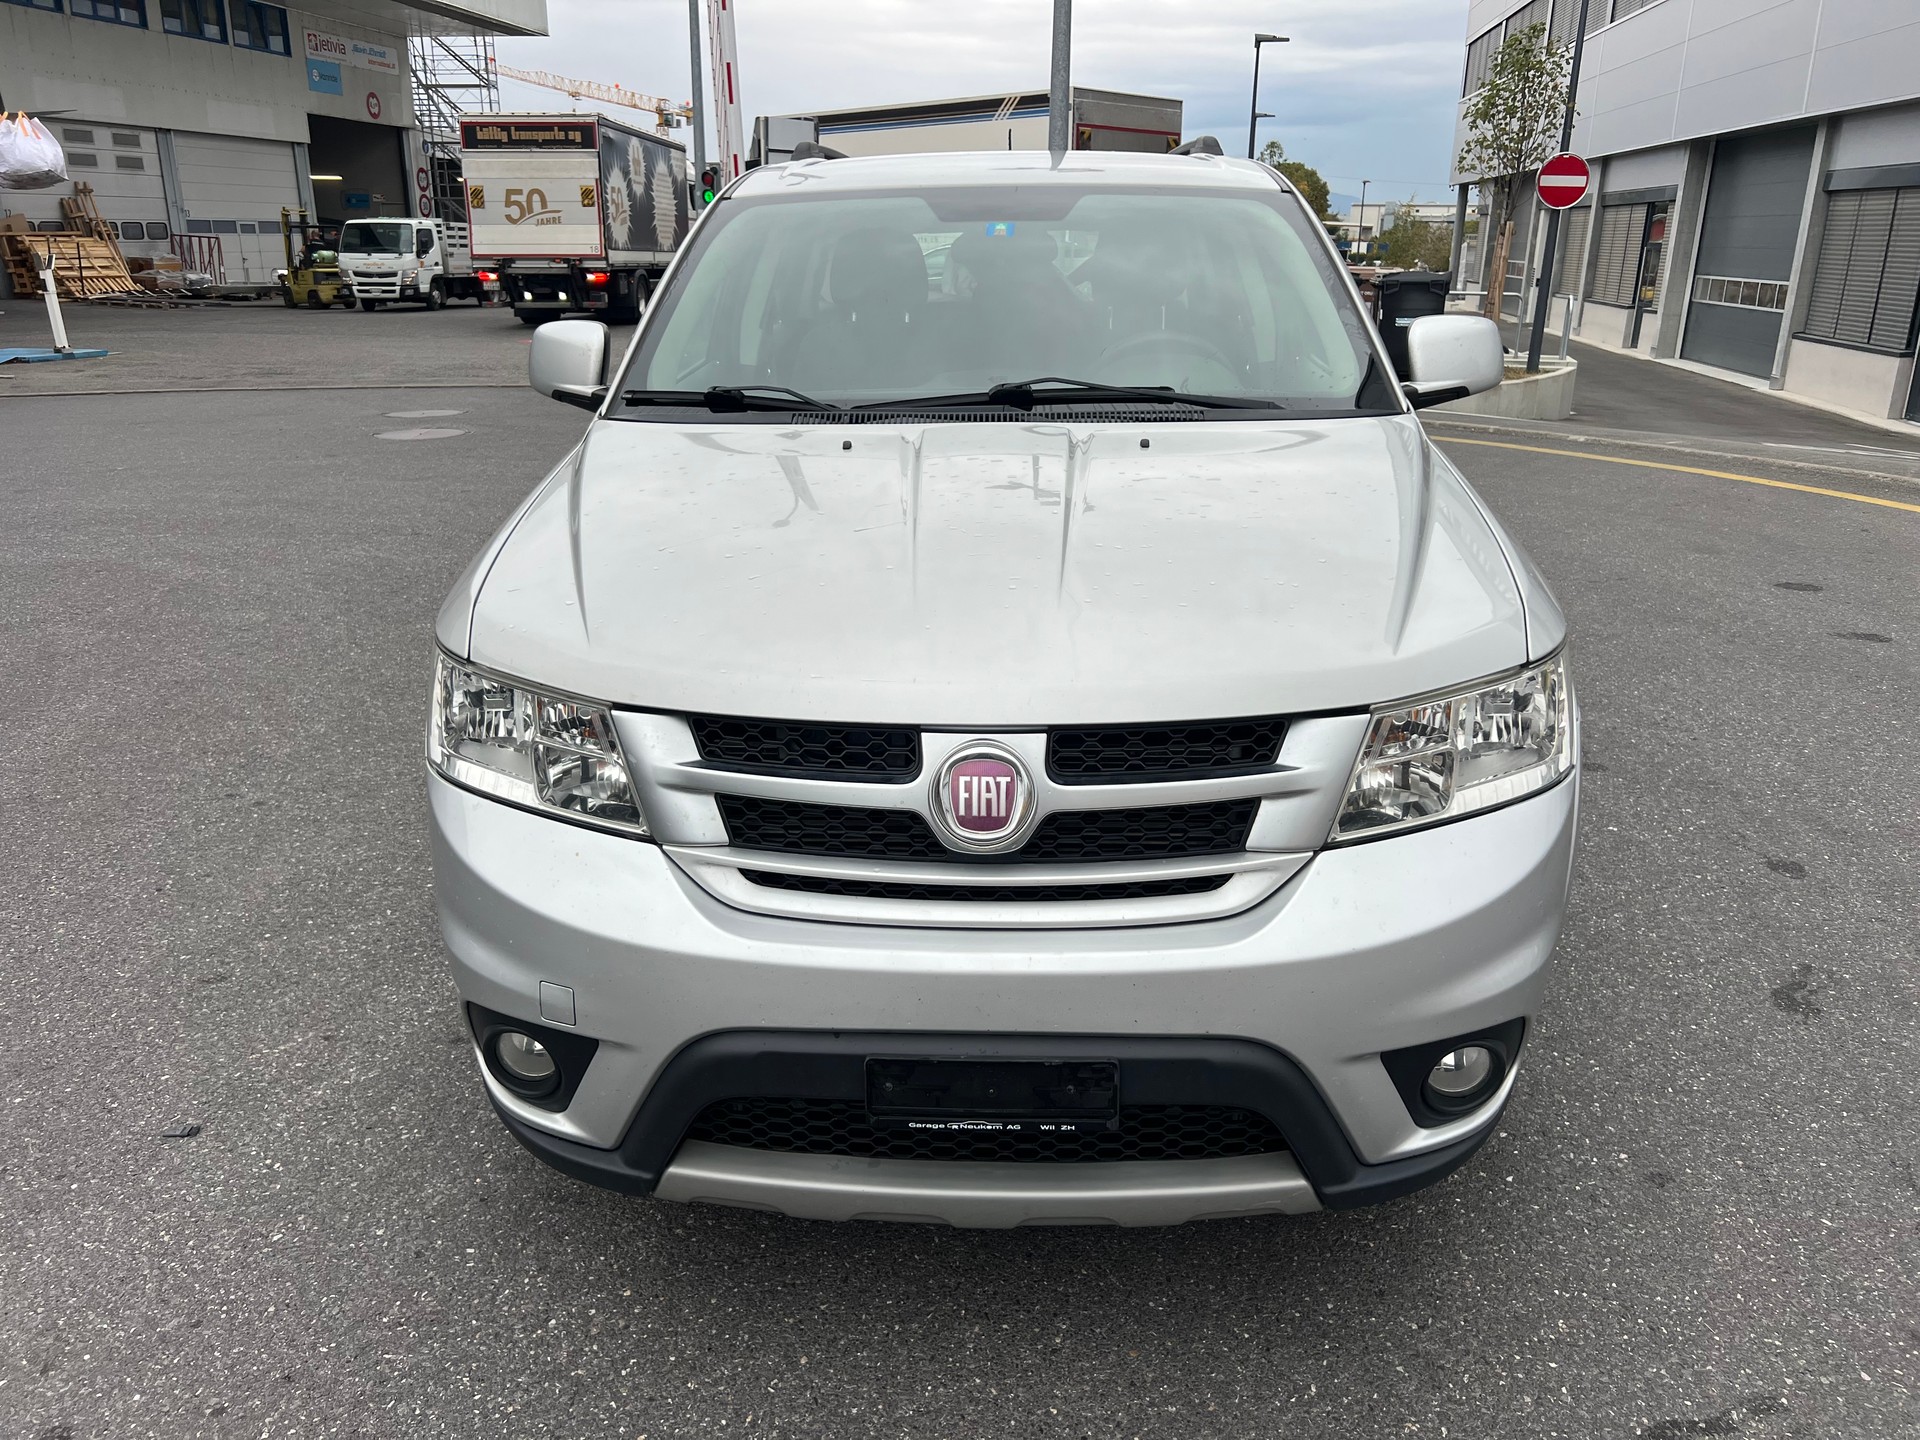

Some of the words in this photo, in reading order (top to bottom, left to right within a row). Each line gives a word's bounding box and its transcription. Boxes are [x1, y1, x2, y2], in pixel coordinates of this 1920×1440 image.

[511, 126, 565, 142] transporte
[568, 131, 582, 142] ag
[504, 188, 549, 225] 50
[535, 216, 562, 227] JAHRE
[589, 245, 600, 253] 18
[958, 775, 1011, 817] FIAT
[908, 1122, 946, 1130] Garage
